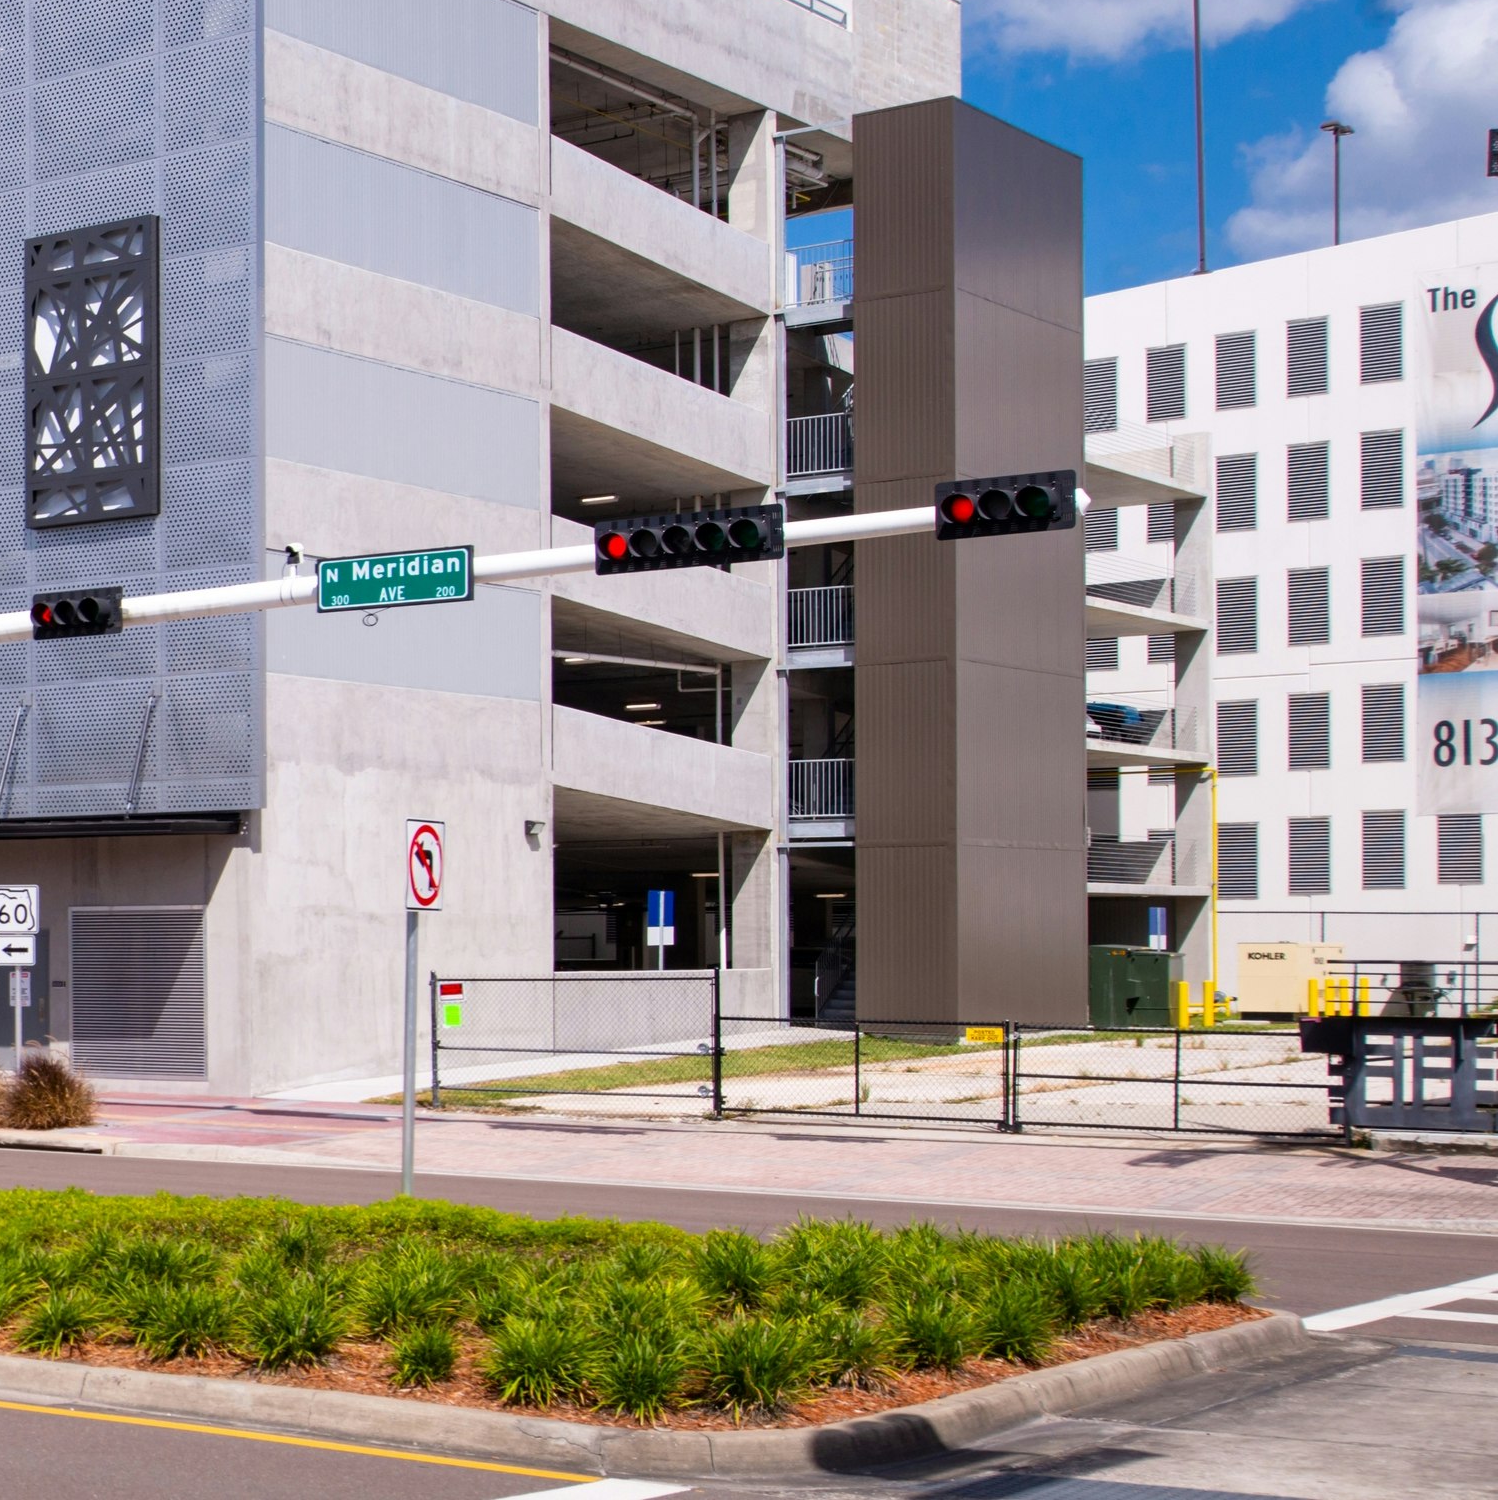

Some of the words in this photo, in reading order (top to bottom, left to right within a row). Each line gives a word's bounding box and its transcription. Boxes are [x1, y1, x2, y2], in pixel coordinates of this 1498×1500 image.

[1427, 286, 1476, 313] The
[326, 568, 338, 583] N
[352, 555, 460, 581] Meridian
[331, 595, 350, 606] 300
[379, 586, 406, 602] AVE
[435, 586, 456, 598] 200
[1434, 718, 1498, 767] 813
[1247, 952, 1285, 961] KOHLER
